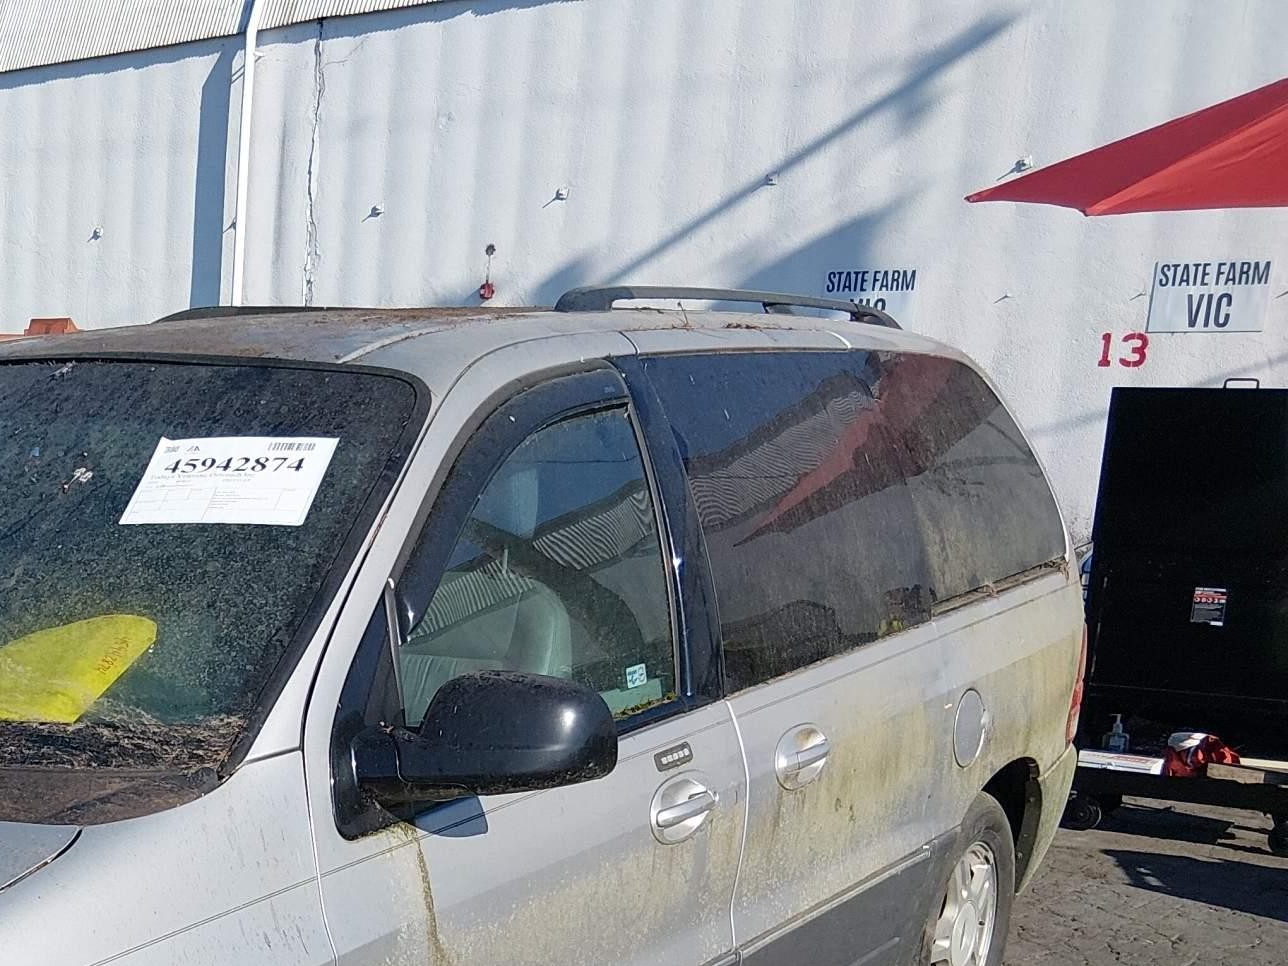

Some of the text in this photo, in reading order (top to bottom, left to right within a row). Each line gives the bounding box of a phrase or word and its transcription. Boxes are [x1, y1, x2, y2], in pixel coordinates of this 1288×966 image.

[826, 269, 917, 293] STATE FARM
[1159, 261, 1271, 287] STATE FARM
[1186, 293, 1233, 329] VIC
[1098, 332, 1149, 368] 13
[164, 456, 306, 474] 45942874
